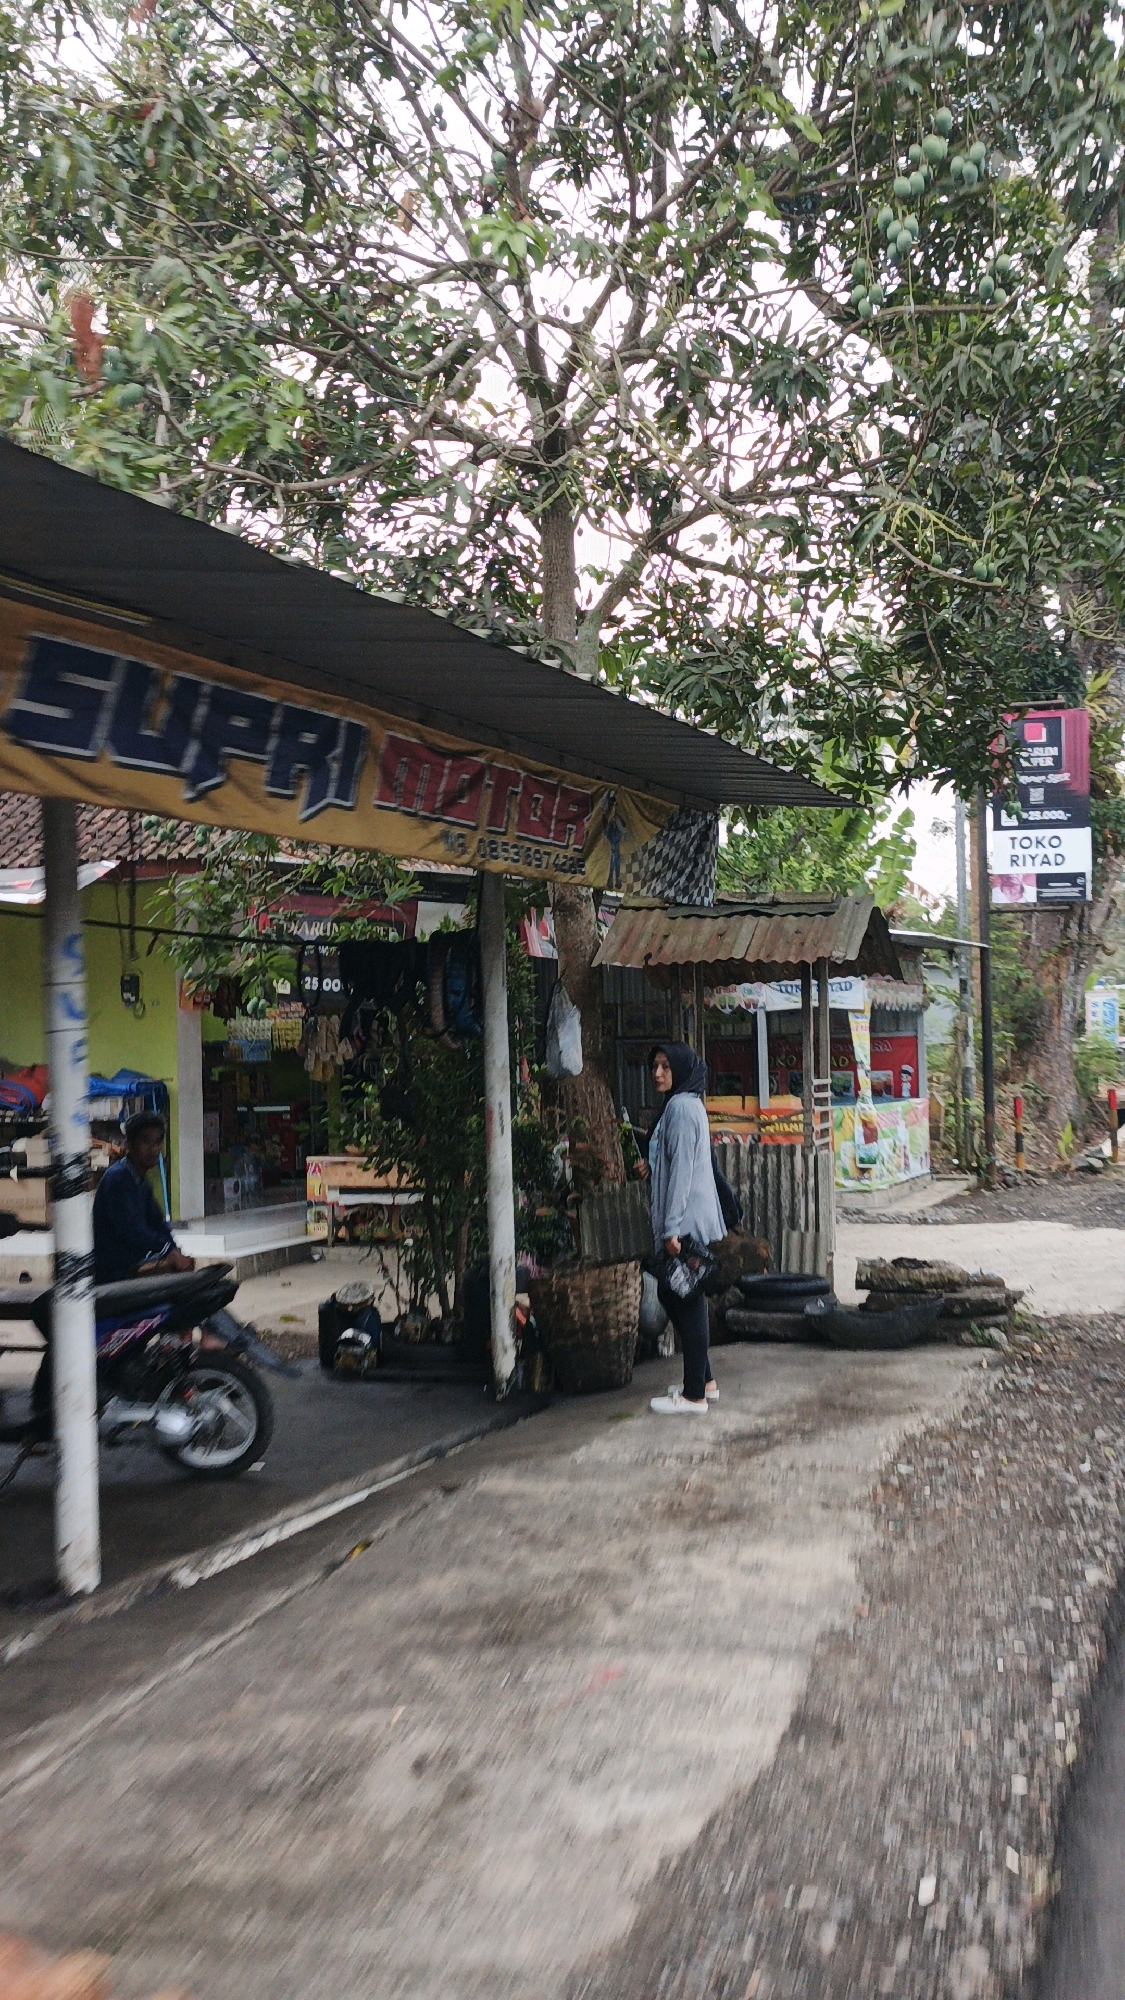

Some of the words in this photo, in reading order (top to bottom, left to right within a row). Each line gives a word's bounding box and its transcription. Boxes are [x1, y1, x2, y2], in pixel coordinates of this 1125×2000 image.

[372, 730, 593, 850] MOTOR
[1009, 836, 1062, 849] TOKO
[1010, 854, 1066, 868] RIYAD
